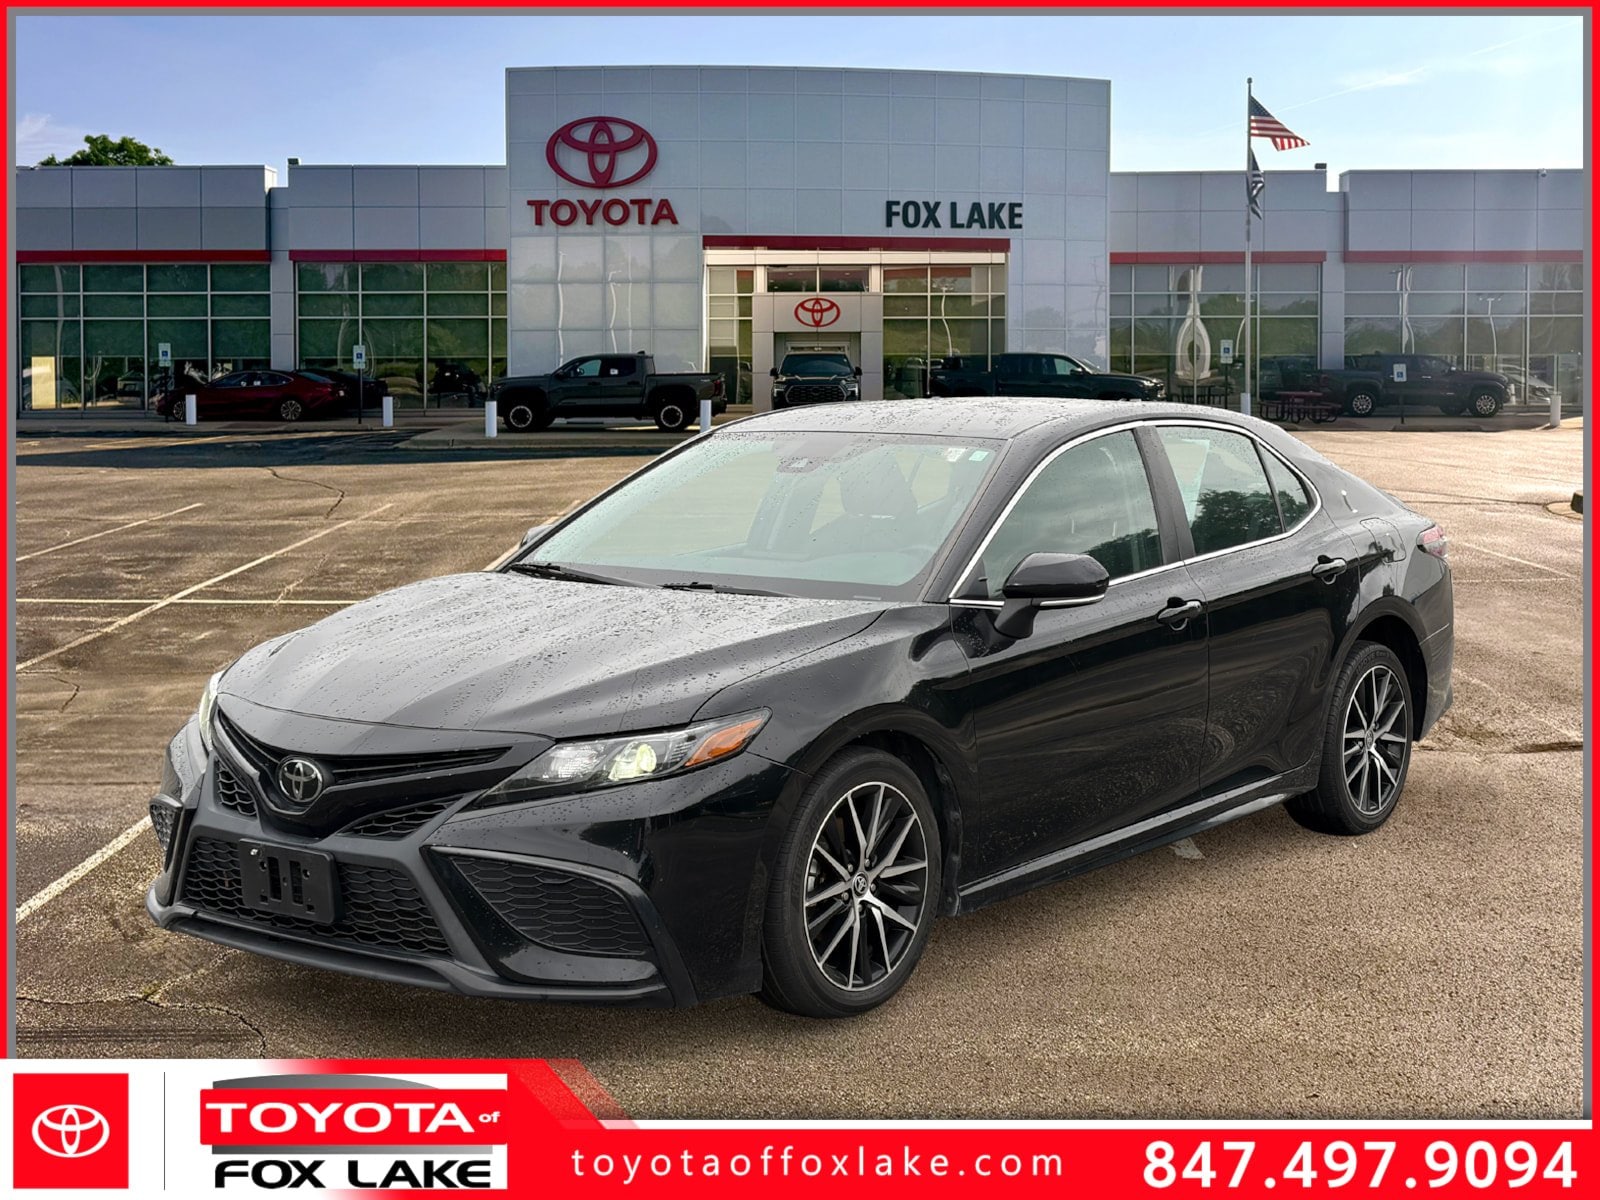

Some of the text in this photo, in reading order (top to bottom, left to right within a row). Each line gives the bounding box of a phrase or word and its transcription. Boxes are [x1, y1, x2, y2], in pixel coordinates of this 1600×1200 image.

[527, 199, 679, 227] TOYOTA
[885, 200, 1023, 230] FOX LAKE
